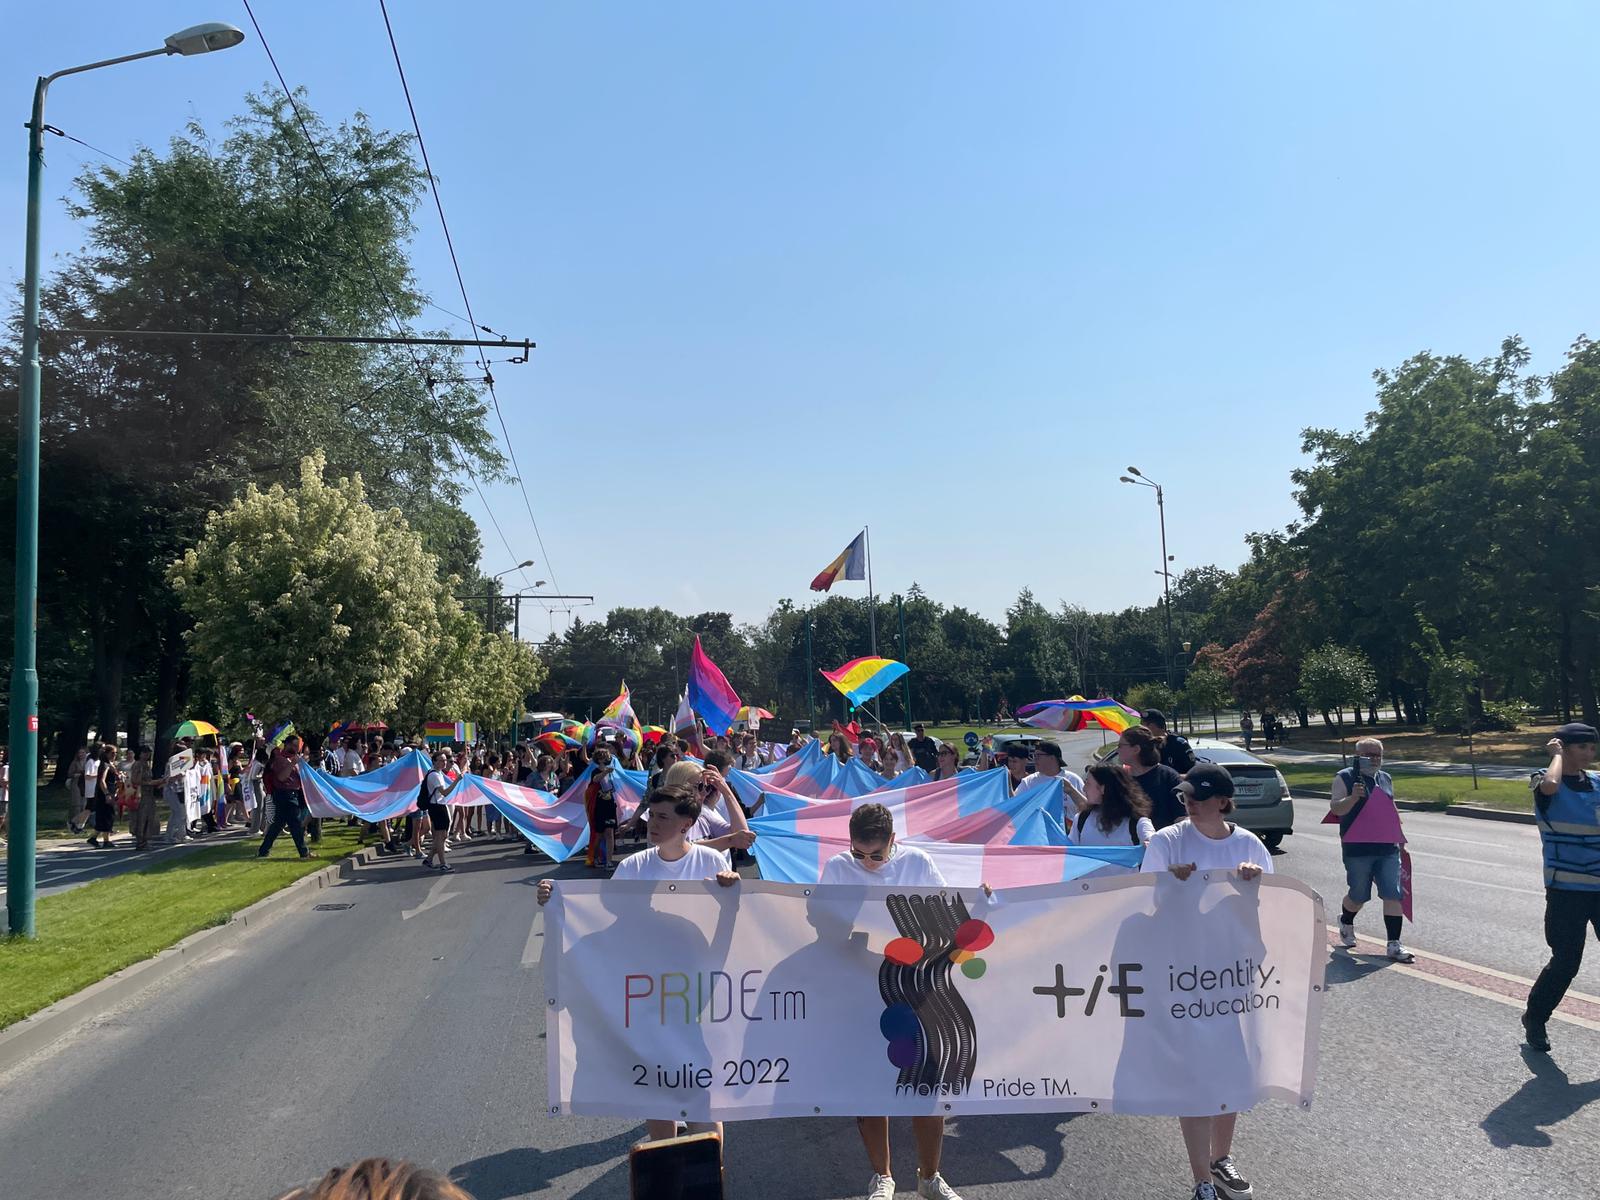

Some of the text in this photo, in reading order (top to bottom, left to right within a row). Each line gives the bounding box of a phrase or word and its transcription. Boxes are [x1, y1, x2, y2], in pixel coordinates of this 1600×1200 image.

[1168, 958, 1281, 992] identity.
[624, 969, 763, 1028] PRIDE
[1170, 991, 1280, 1019] education
[632, 1057, 790, 1088] 2 iulie 2022
[983, 1078, 1036, 1098] Pride
[1040, 1077, 1077, 1097] TM.
